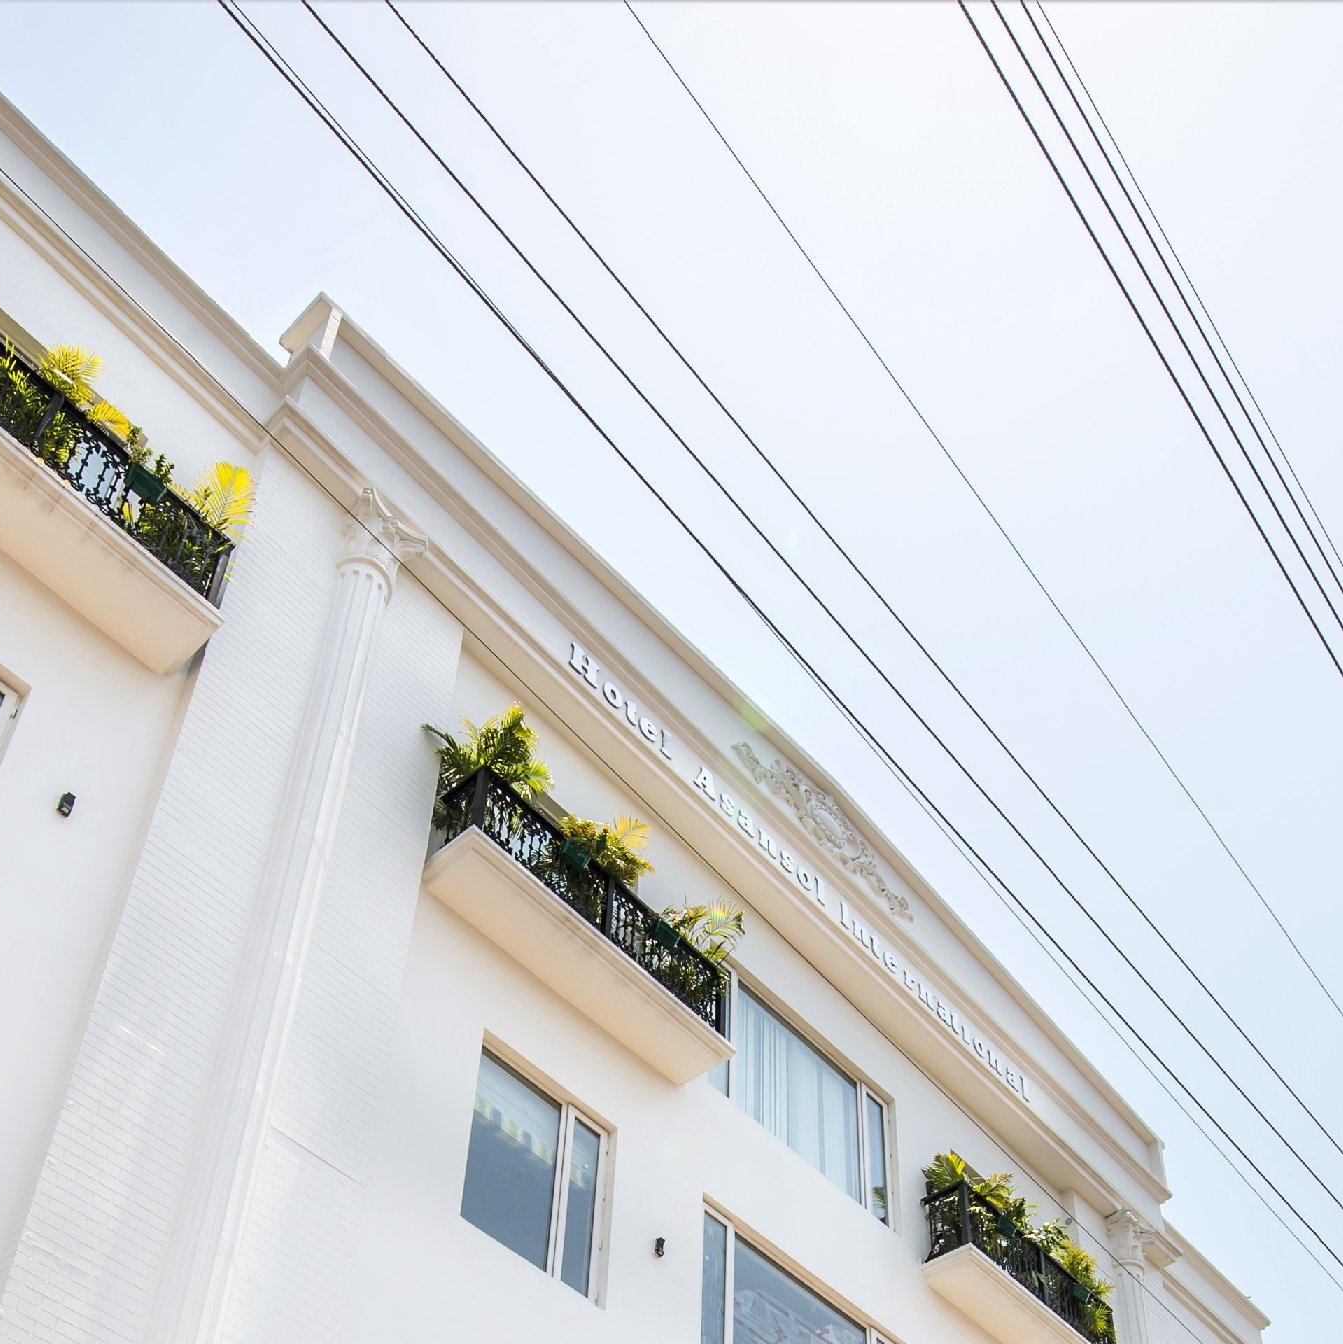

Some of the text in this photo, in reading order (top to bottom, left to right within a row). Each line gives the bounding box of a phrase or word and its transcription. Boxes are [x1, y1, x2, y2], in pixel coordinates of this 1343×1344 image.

[568, 641, 1034, 1104] Hotel Asansol International
